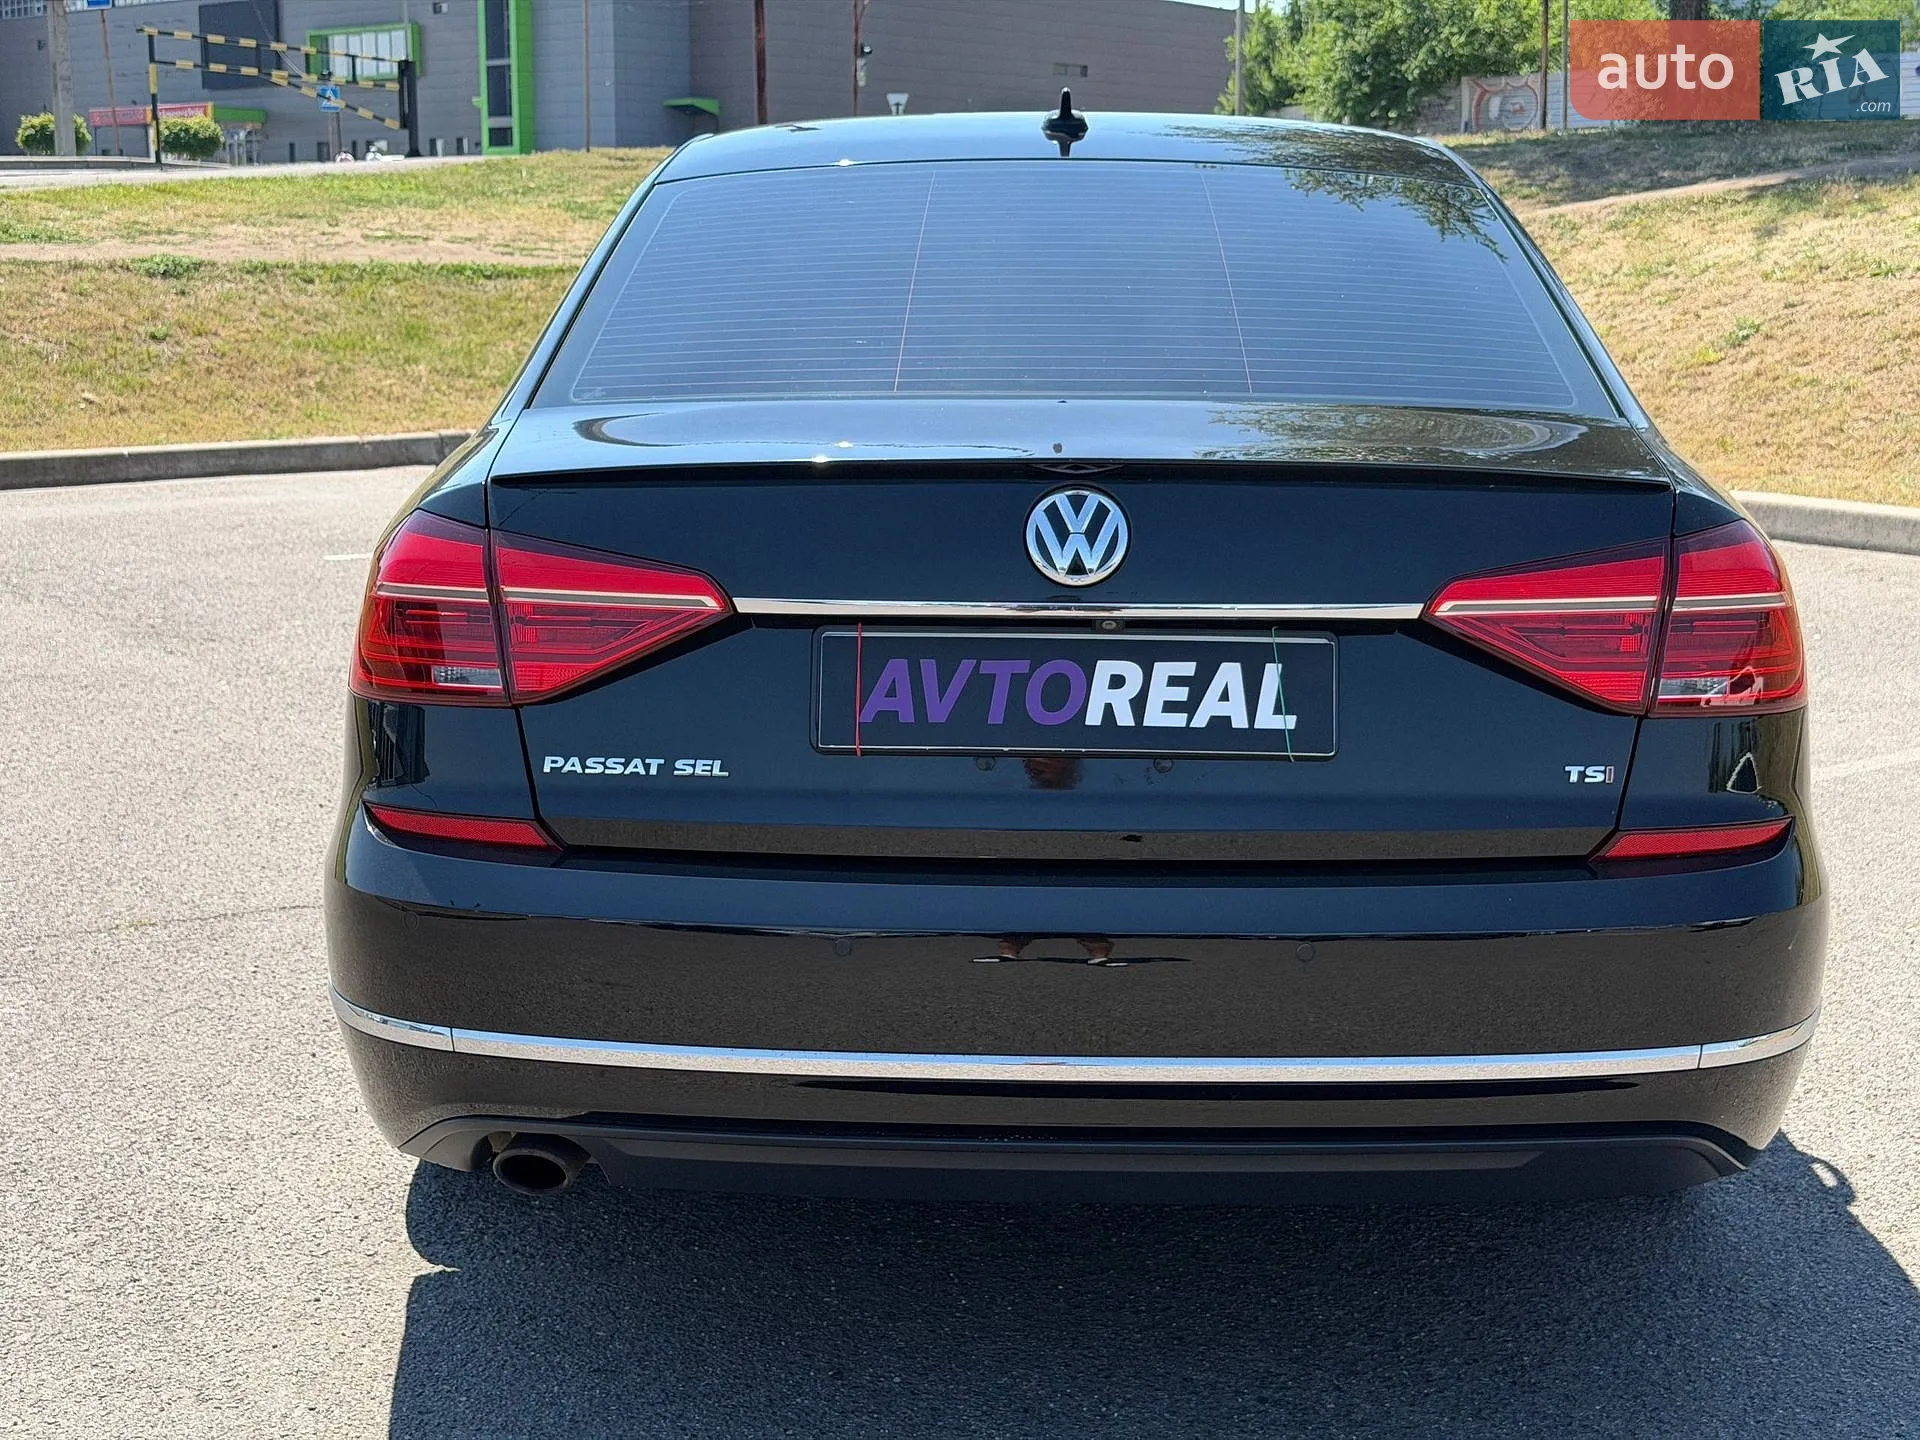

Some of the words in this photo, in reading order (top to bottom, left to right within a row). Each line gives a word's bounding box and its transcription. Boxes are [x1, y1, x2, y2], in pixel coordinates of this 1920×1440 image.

[1030, 491, 1124, 582] VW
[859, 658, 1297, 730] AVTOREAL
[543, 756, 665, 776] PASSAT
[673, 759, 729, 777] SEL
[1564, 765, 1615, 784] TSI
